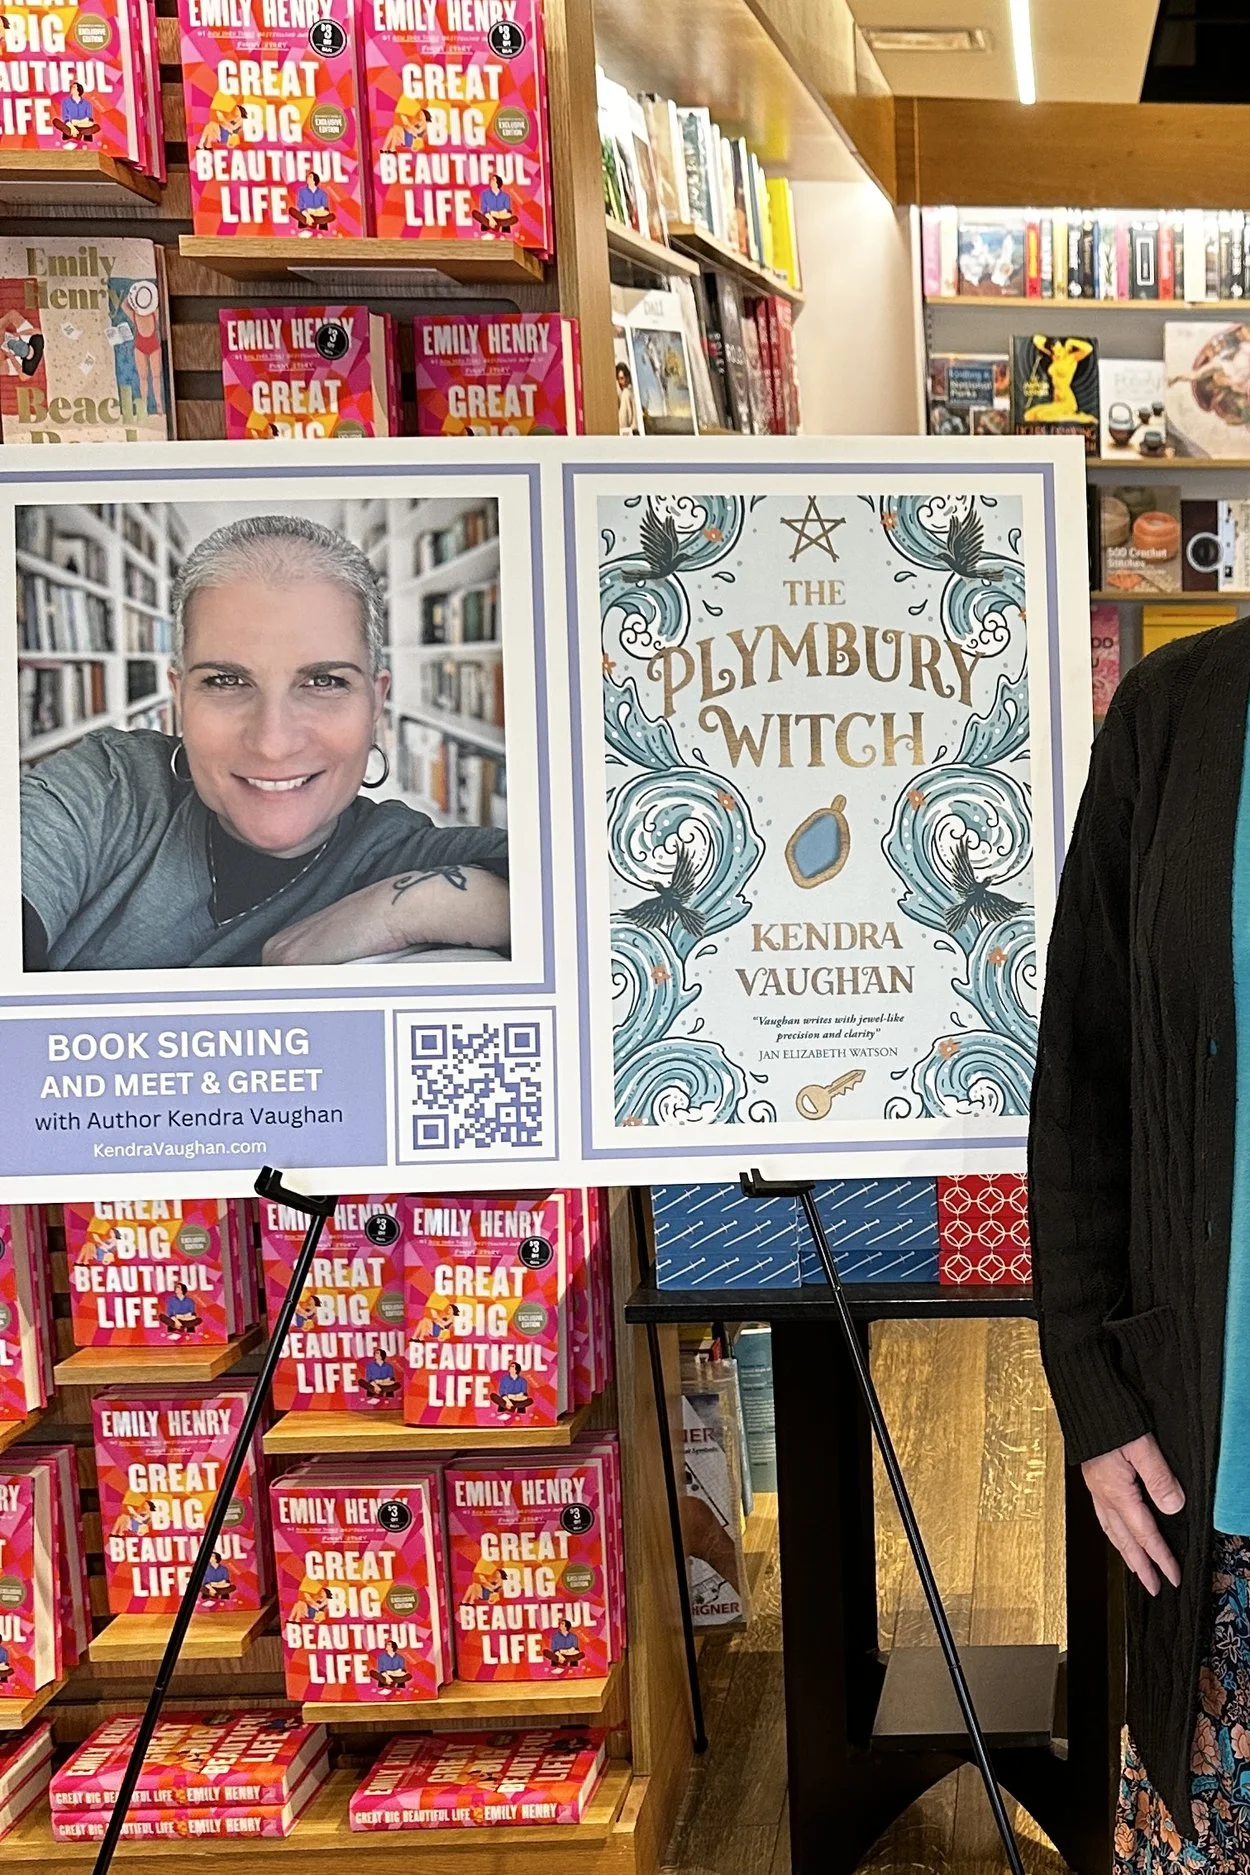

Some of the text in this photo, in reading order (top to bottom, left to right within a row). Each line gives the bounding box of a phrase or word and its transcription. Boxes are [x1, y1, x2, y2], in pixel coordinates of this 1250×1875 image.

[189, 0, 333, 28] EMILY HENRY
[373, 0, 517, 33] EMILY HENRY
[6, 13, 66, 56] BIG
[217, 59, 319, 97] GREAT
[402, 63, 503, 101] GREAT
[0, 97, 54, 136] IFE
[242, 103, 303, 144] BIG
[427, 107, 486, 146] BIG
[198, 150, 349, 183] BEAUTIFUL
[380, 153, 532, 185] BEAUTIFUL
[220, 186, 290, 224] LIFE
[404, 188, 472, 227] LIFE
[26, 246, 118, 286] Emily
[24, 279, 125, 318] Henry
[227, 319, 282, 351] EMILY
[422, 322, 550, 356] EMILY HENRY
[16, 384, 148, 424] Beach
[252, 379, 342, 415] GREAT
[448, 384, 537, 418] GREAT
[783, 579, 846, 606] THE
[647, 621, 985, 720] PLYMBURY
[699, 704, 925, 768] WITCH
[751, 921, 904, 952] KENDRA
[735, 965, 915, 997] VAUGHAN
[803, 1015, 832, 1026] writes
[835, 1013, 857, 1025] with
[857, 1012, 904, 1026] jewel-like
[48, 1027, 310, 1062] BOOK SIGNING
[776, 1030, 820, 1043] precision
[822, 1029, 842, 1040] and
[758, 1046, 898, 1062] JAN ELIZABETH WATSON
[40, 1068, 323, 1099] AND MEET & GREET
[35, 1104, 345, 1131] with Author Kendra Vaughan
[93, 1139, 267, 1159] KendraVaughan.com
[94, 1200, 184, 1220] GREAT
[376, 1217, 387, 1231] $3
[413, 1208, 544, 1238] EMILY HENRY
[117, 1227, 171, 1259] BIG
[529, 1240, 540, 1253] $3
[74, 1265, 213, 1293] BEAUTIFUL
[435, 1264, 527, 1297] GREAT
[97, 1297, 160, 1328] LIFE
[315, 1293, 370, 1326] BIG
[454, 1303, 508, 1337] BIG
[409, 1342, 548, 1371] BEAUTIFUL
[297, 1362, 359, 1394] LIFE
[428, 1375, 491, 1407] LIFE
[101, 1409, 231, 1437] EMILY HENRY
[128, 1462, 219, 1492] GREAT
[455, 1477, 585, 1506] EMILY HENRY
[150, 1498, 205, 1531] BIG
[279, 1497, 336, 1524] EMILY
[388, 1506, 399, 1517] $3
[570, 1508, 581, 1519] $3
[481, 1530, 572, 1561] GREAT
[305, 1550, 396, 1580] GREAT
[502, 1566, 556, 1598] BIG
[327, 1586, 382, 1618] BIG
[460, 1602, 597, 1630] BEAUTIFUL
[692, 1602, 740, 1616] IGNER
[286, 1623, 423, 1650] BEAUTIFUL
[482, 1633, 544, 1664] LIFE
[308, 1654, 371, 1684] LIFE
[66, 1747, 111, 1777] EMILY
[241, 1731, 291, 1763] LIFE
[364, 1768, 405, 1796] EMILY
[535, 1753, 577, 1782] LIFE
[55, 1785, 261, 1805] GREAT BIG LIFE EMILY HENRY
[59, 1817, 261, 1837] GREAT BIG LIFE EMILY HENRY
[355, 1803, 557, 1824] GREAT BIG BEAUTIFUL LIFE EMILY HENRY
